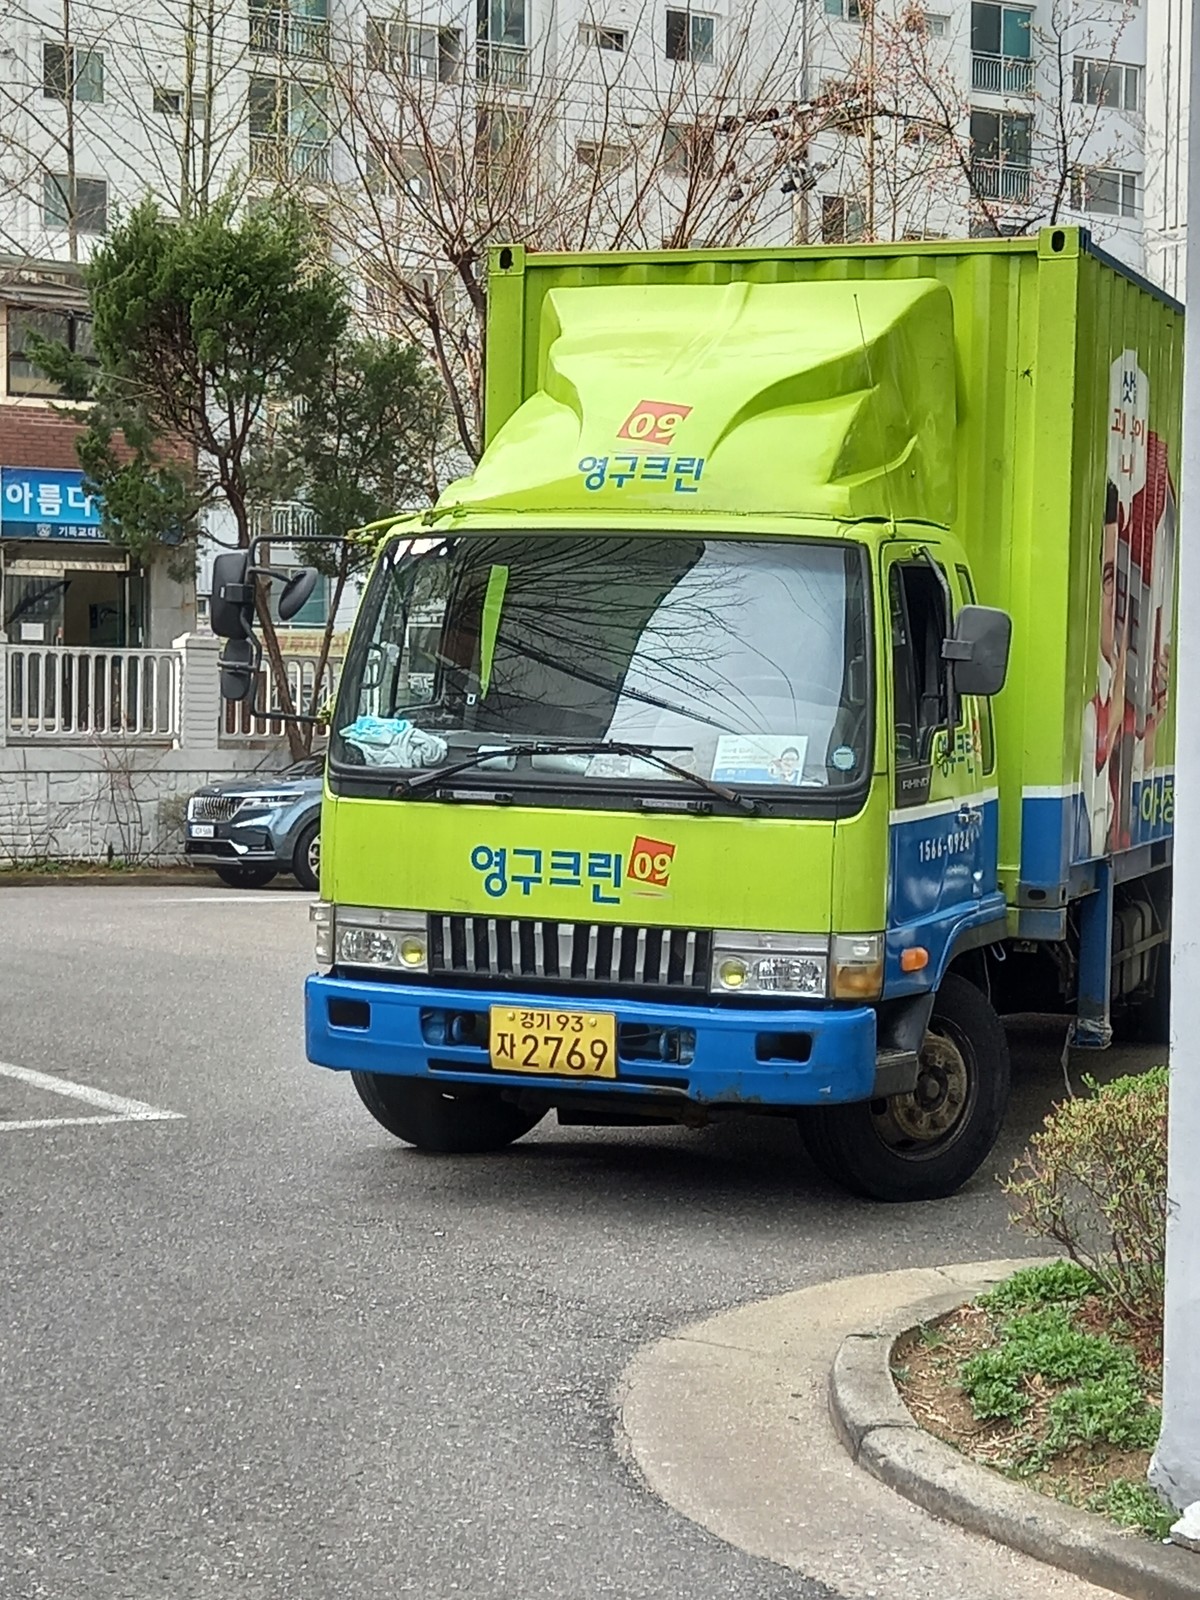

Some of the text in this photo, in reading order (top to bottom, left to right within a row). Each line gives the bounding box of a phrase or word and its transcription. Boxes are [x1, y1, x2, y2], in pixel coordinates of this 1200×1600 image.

[627, 412, 685, 439] 09
[578, 456, 705, 492] 영구크린
[471, 845, 672, 904] 영구크린 09
